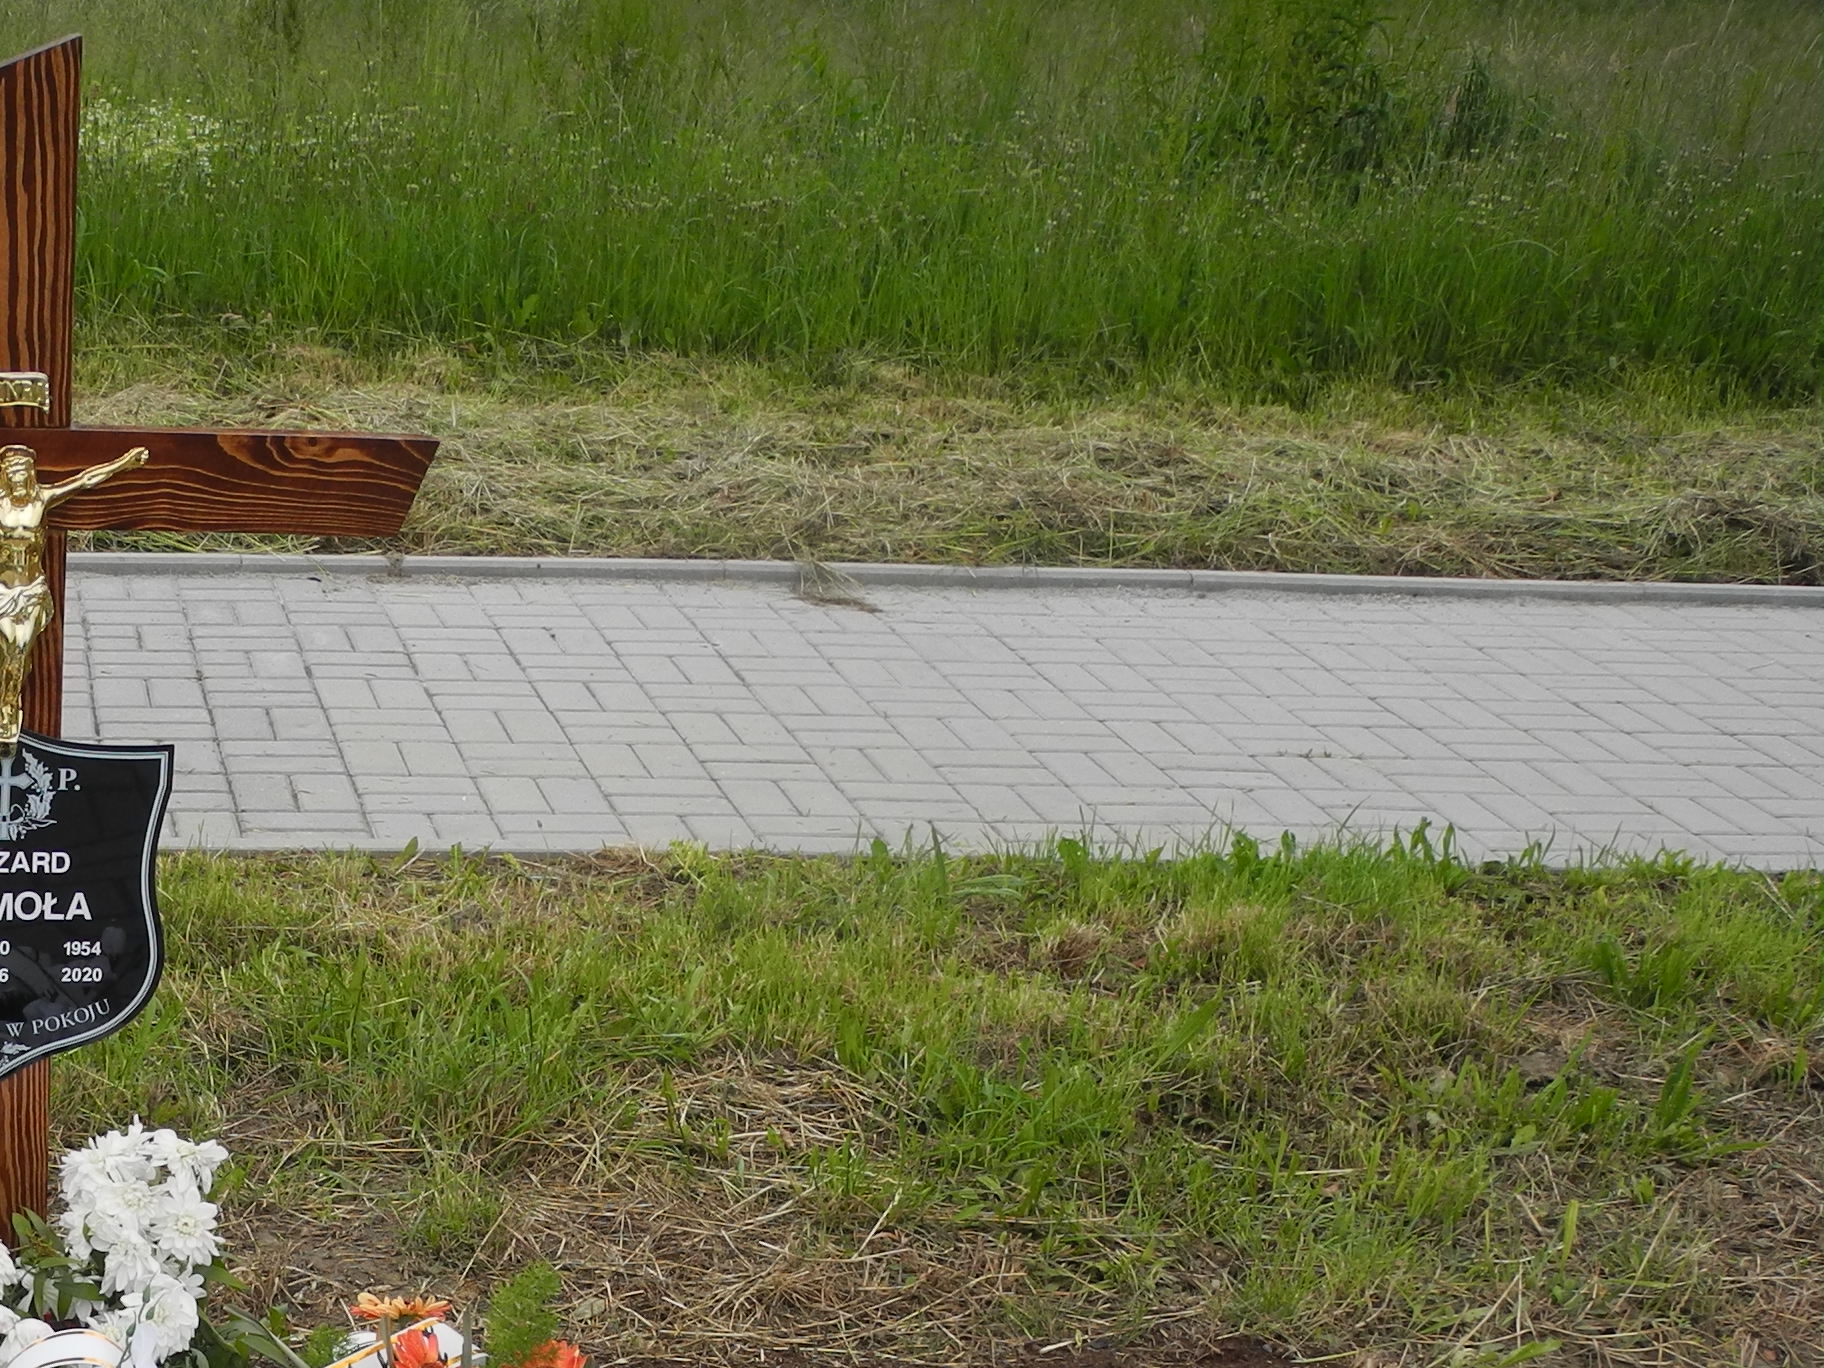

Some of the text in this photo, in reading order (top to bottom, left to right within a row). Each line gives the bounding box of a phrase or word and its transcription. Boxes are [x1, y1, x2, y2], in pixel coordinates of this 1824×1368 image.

[57, 768, 81, 791] P.
[63, 941, 102, 957] 1954
[61, 967, 103, 984] 2020
[5, 1021, 25, 1037] W
[31, 998, 111, 1036] POKOJU
